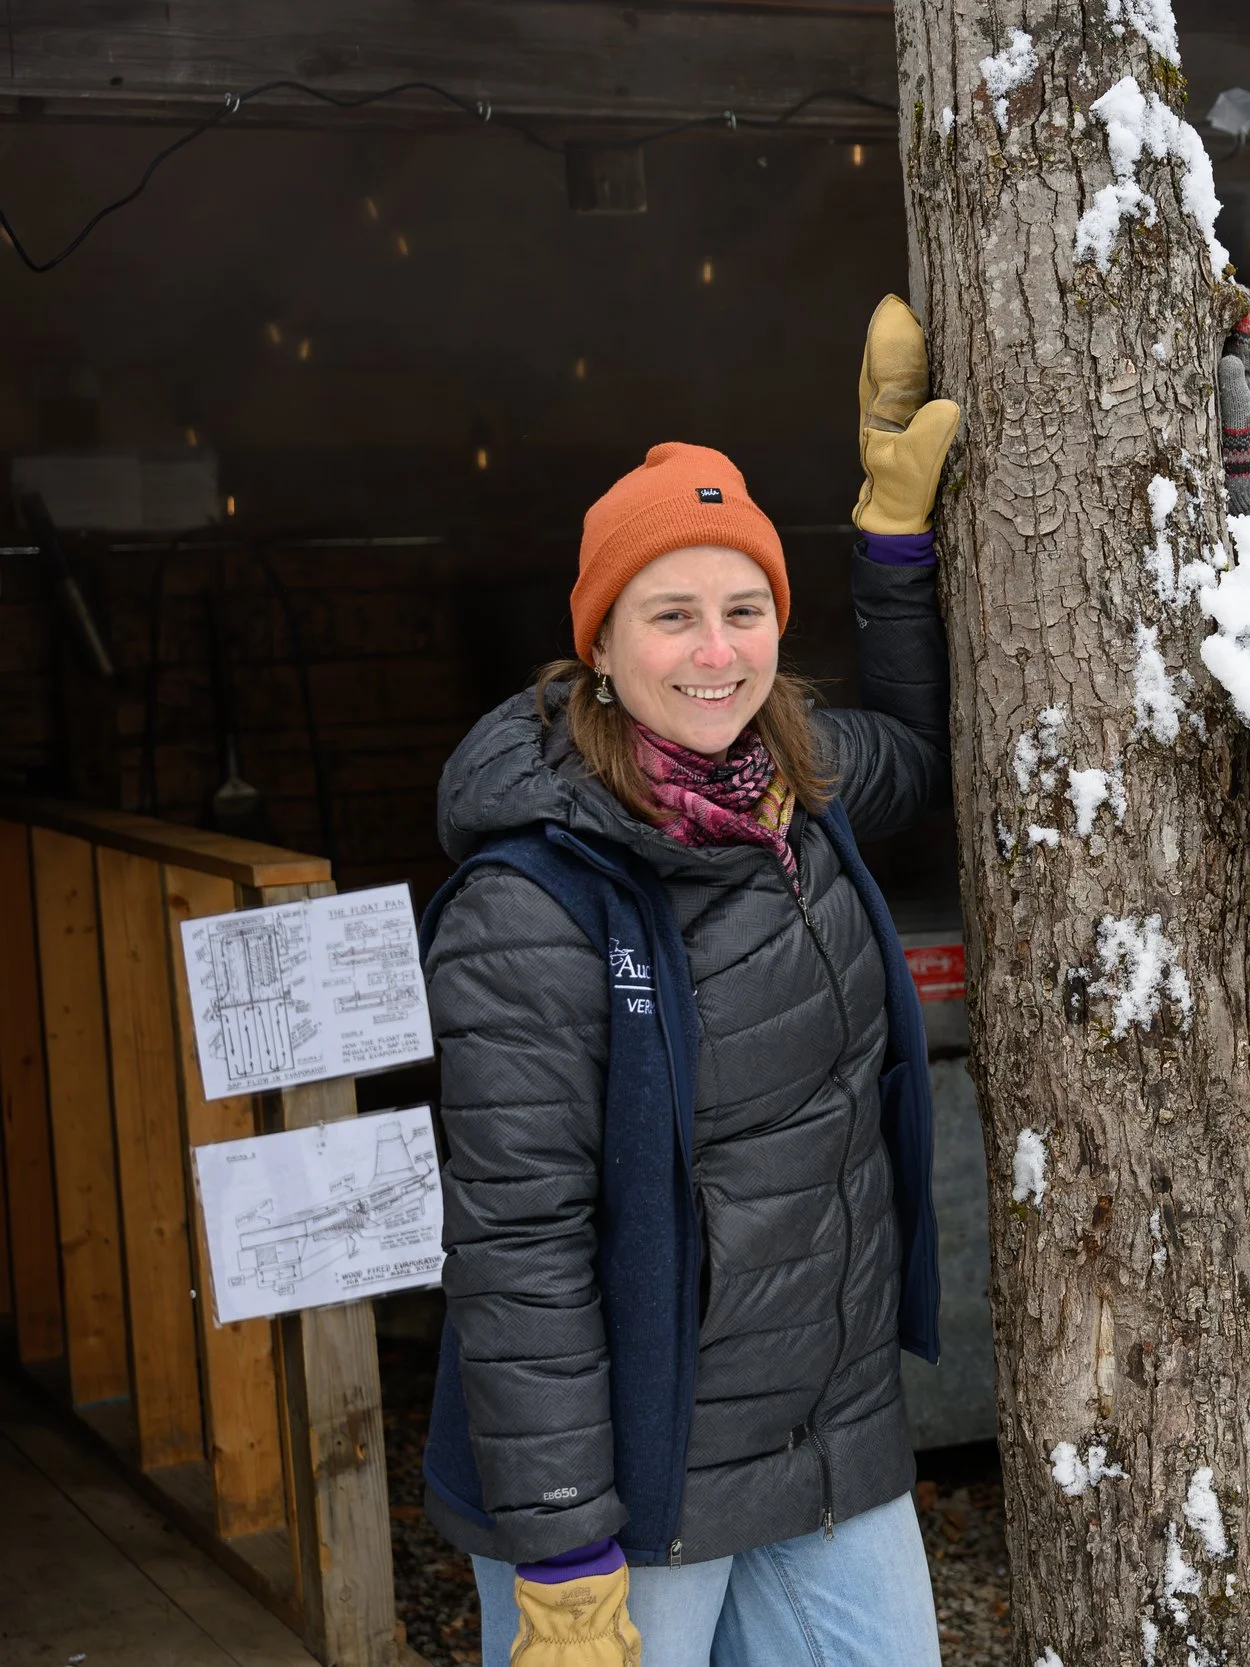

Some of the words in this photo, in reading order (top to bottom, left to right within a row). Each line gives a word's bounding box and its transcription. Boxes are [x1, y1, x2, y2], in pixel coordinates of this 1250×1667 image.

[328, 908, 345, 918] THE
[350, 903, 379, 915] FLOAT
[384, 899, 406, 910] PAN
[543, 1487, 578, 1501] EB650
